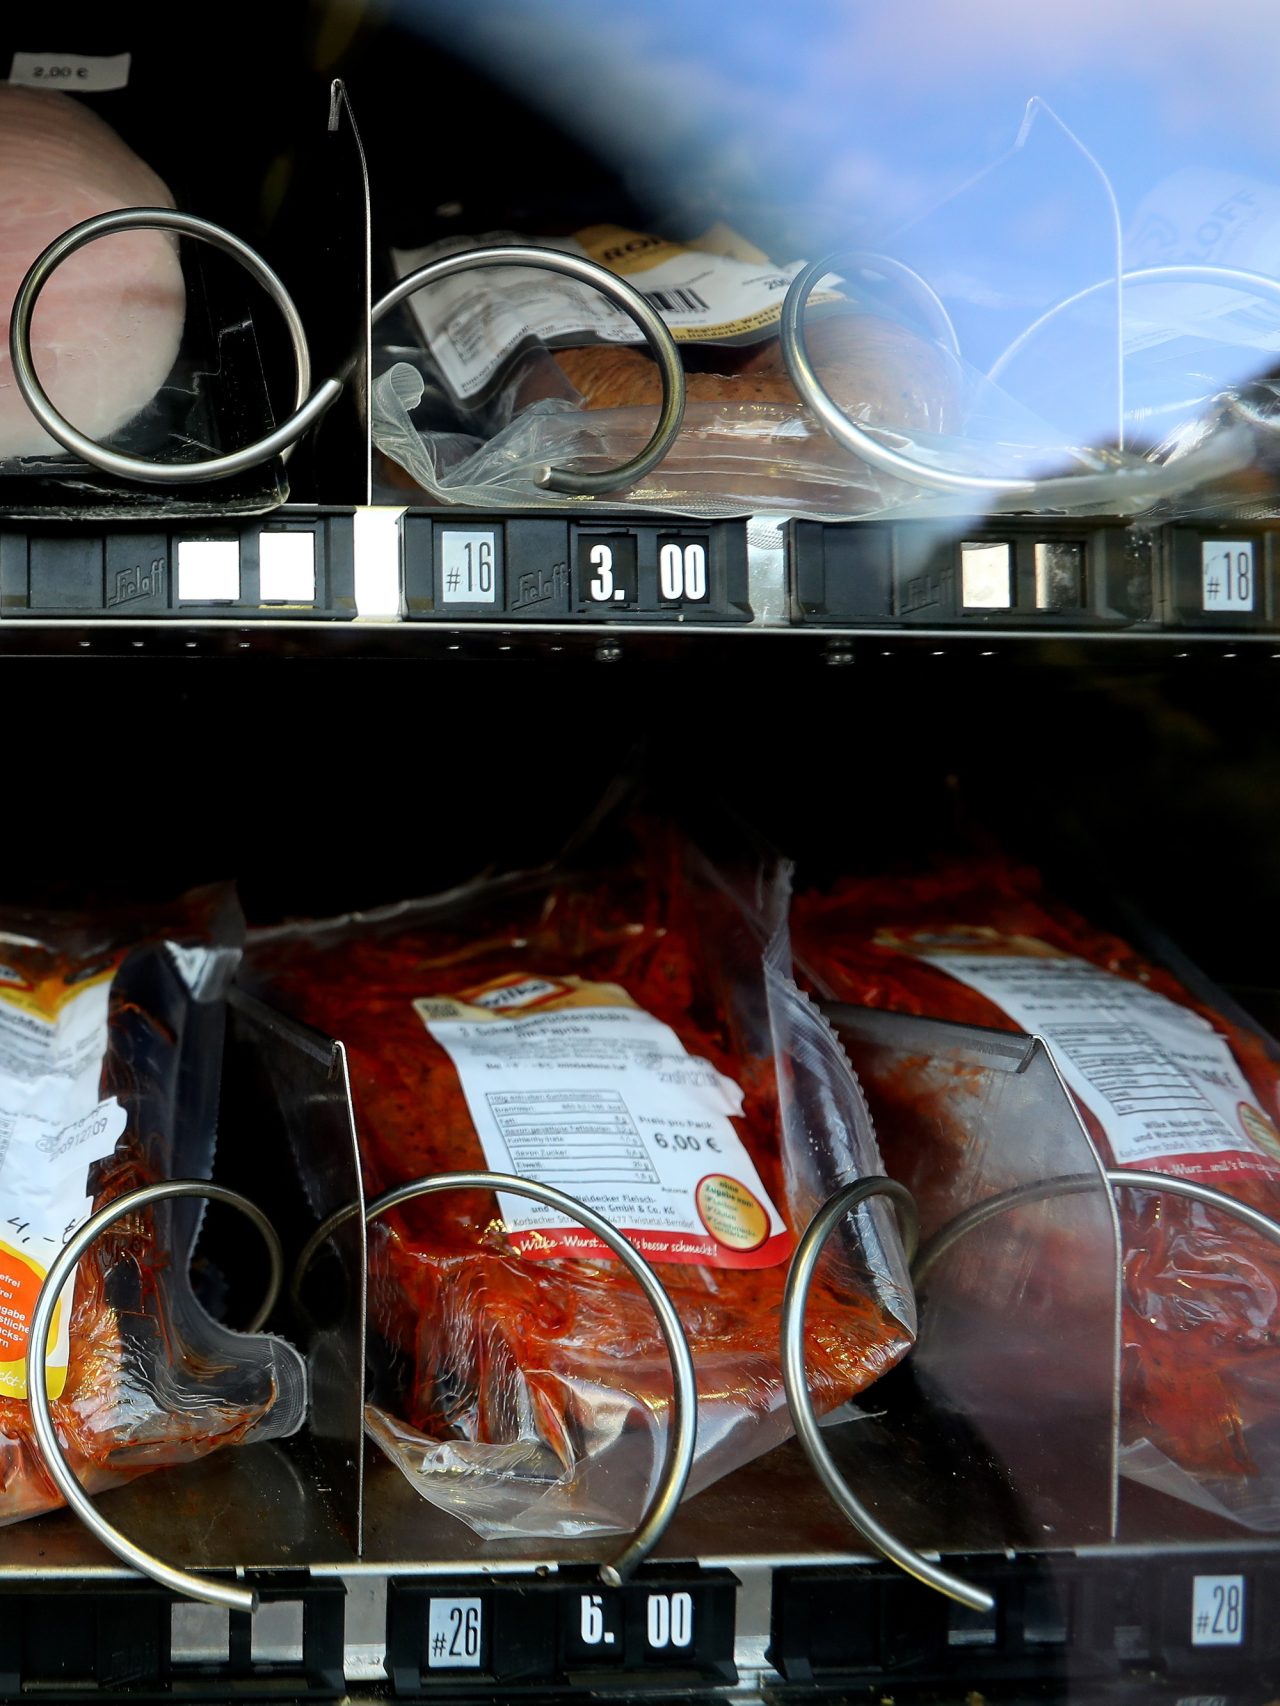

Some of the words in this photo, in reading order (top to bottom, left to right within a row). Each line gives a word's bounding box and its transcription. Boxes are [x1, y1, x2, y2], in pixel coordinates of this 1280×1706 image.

[444, 540, 494, 593] #16
[589, 543, 626, 602] 3.
[659, 542, 707, 601] 00
[1206, 541, 1254, 603] #18
[653, 1132, 702, 1154] 6,00
[705, 1136, 723, 1154] €
[641, 1239, 670, 1252] besser
[431, 1606, 479, 1657] #26
[580, 1594, 615, 1645] 6.
[646, 1592, 693, 1648] 00
[1196, 1584, 1240, 1635] #28
